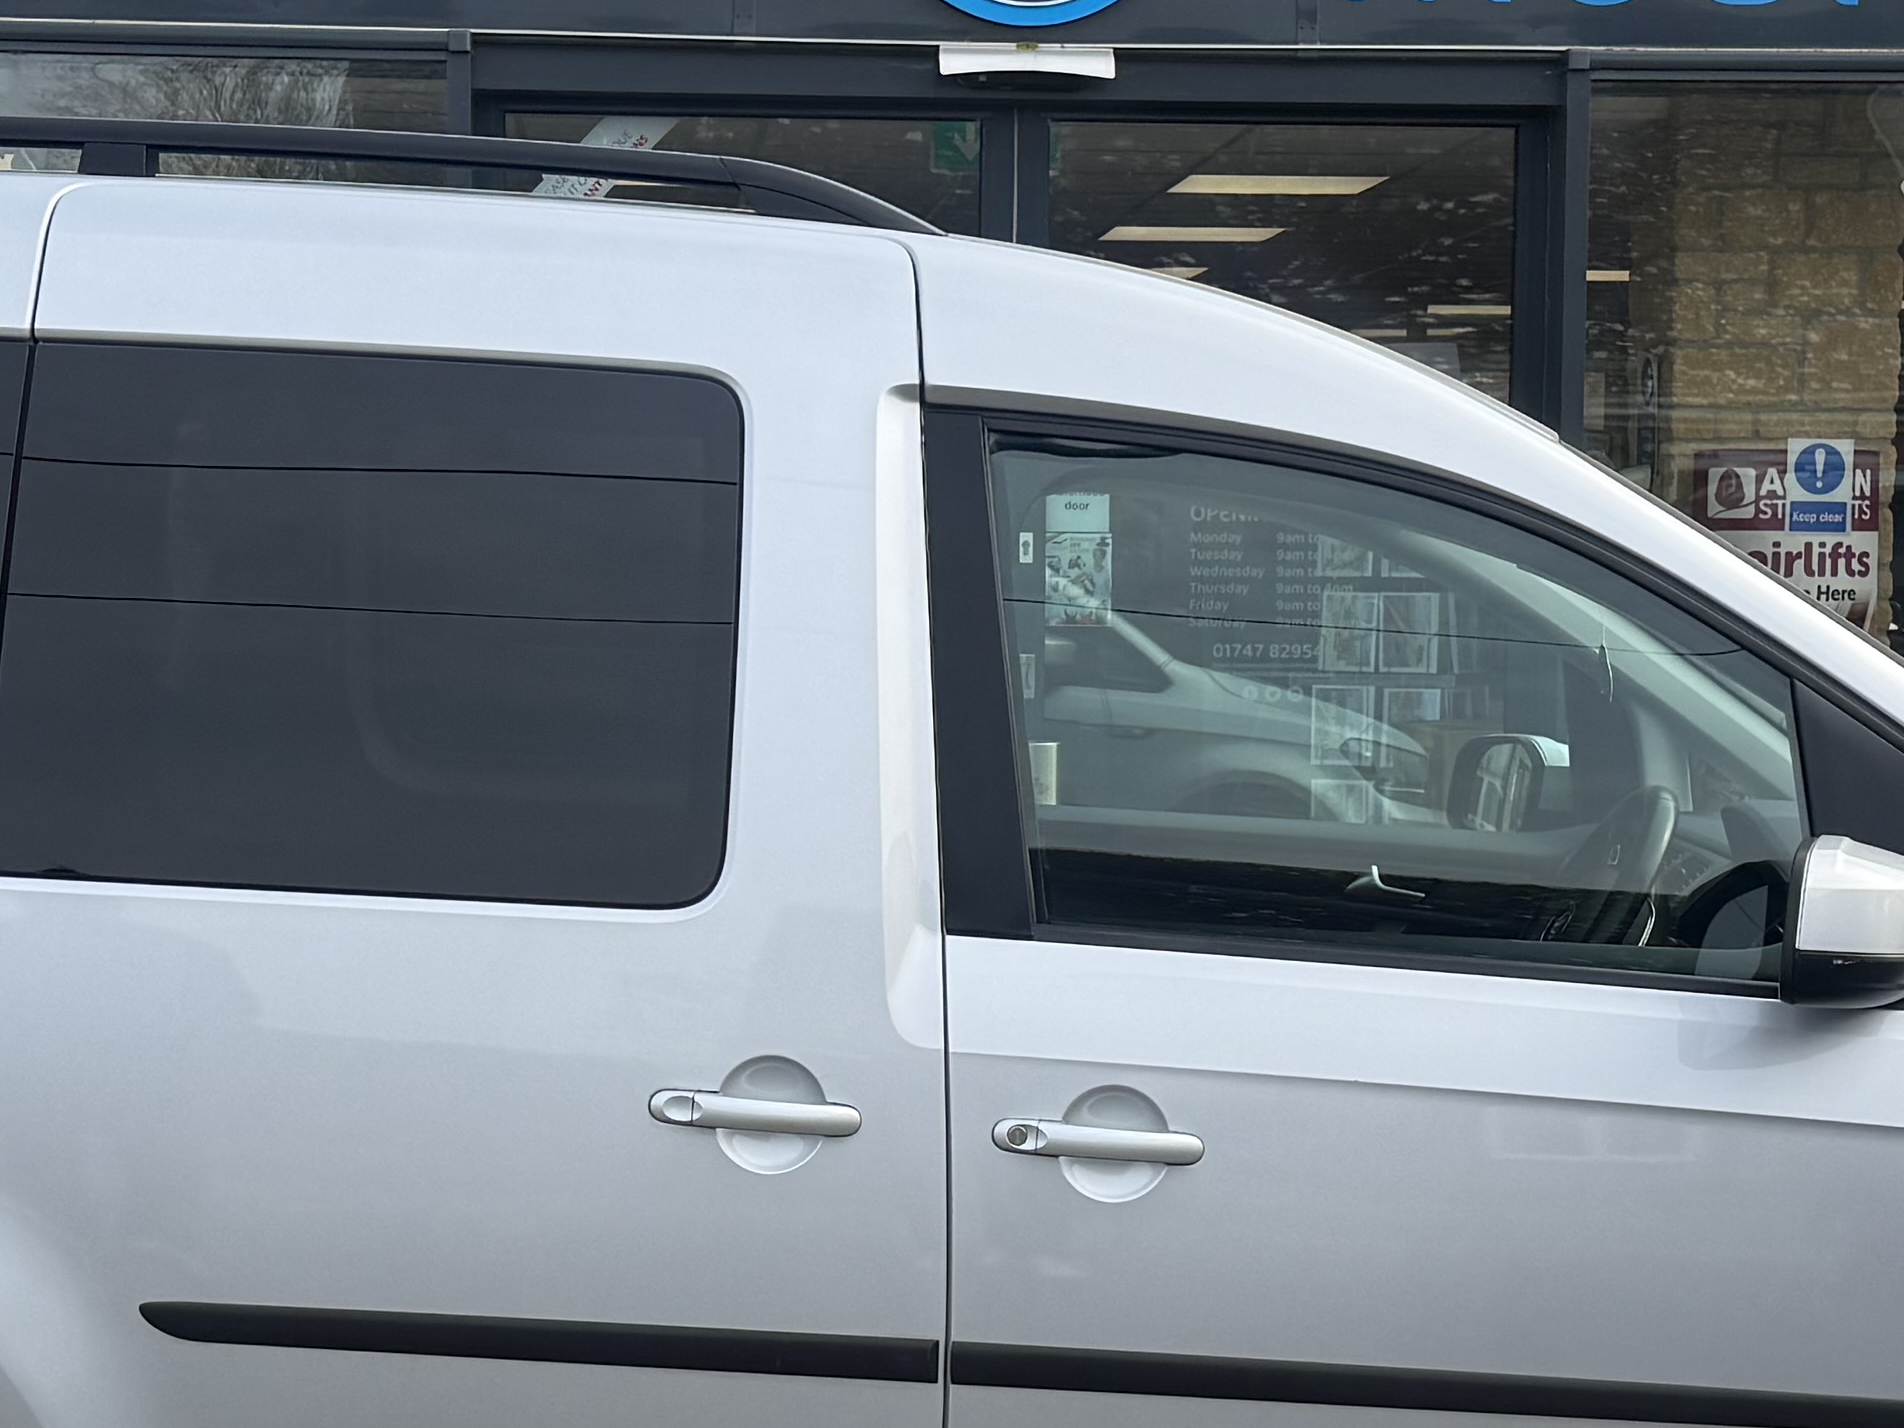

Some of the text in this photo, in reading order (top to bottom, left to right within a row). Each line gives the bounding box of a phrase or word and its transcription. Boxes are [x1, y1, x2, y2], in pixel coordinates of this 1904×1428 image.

[1064, 501, 1090, 511] door
[1792, 511, 1845, 524] Keep clear
[1189, 532, 1243, 545] Monday
[1276, 532, 1304, 543] 9am
[1189, 549, 1244, 561] Tuesday
[1276, 549, 1304, 560] 9am
[1189, 566, 1265, 579] Wednesday
[1276, 566, 1304, 577] 9am
[1189, 583, 1249, 595] Thursday
[1276, 583, 1303, 593] 9am
[1308, 583, 1321, 593] to
[1816, 584, 1857, 602] Here
[1189, 599, 1321, 612] Friday 9am to
[1213, 643, 1264, 659] 01747
